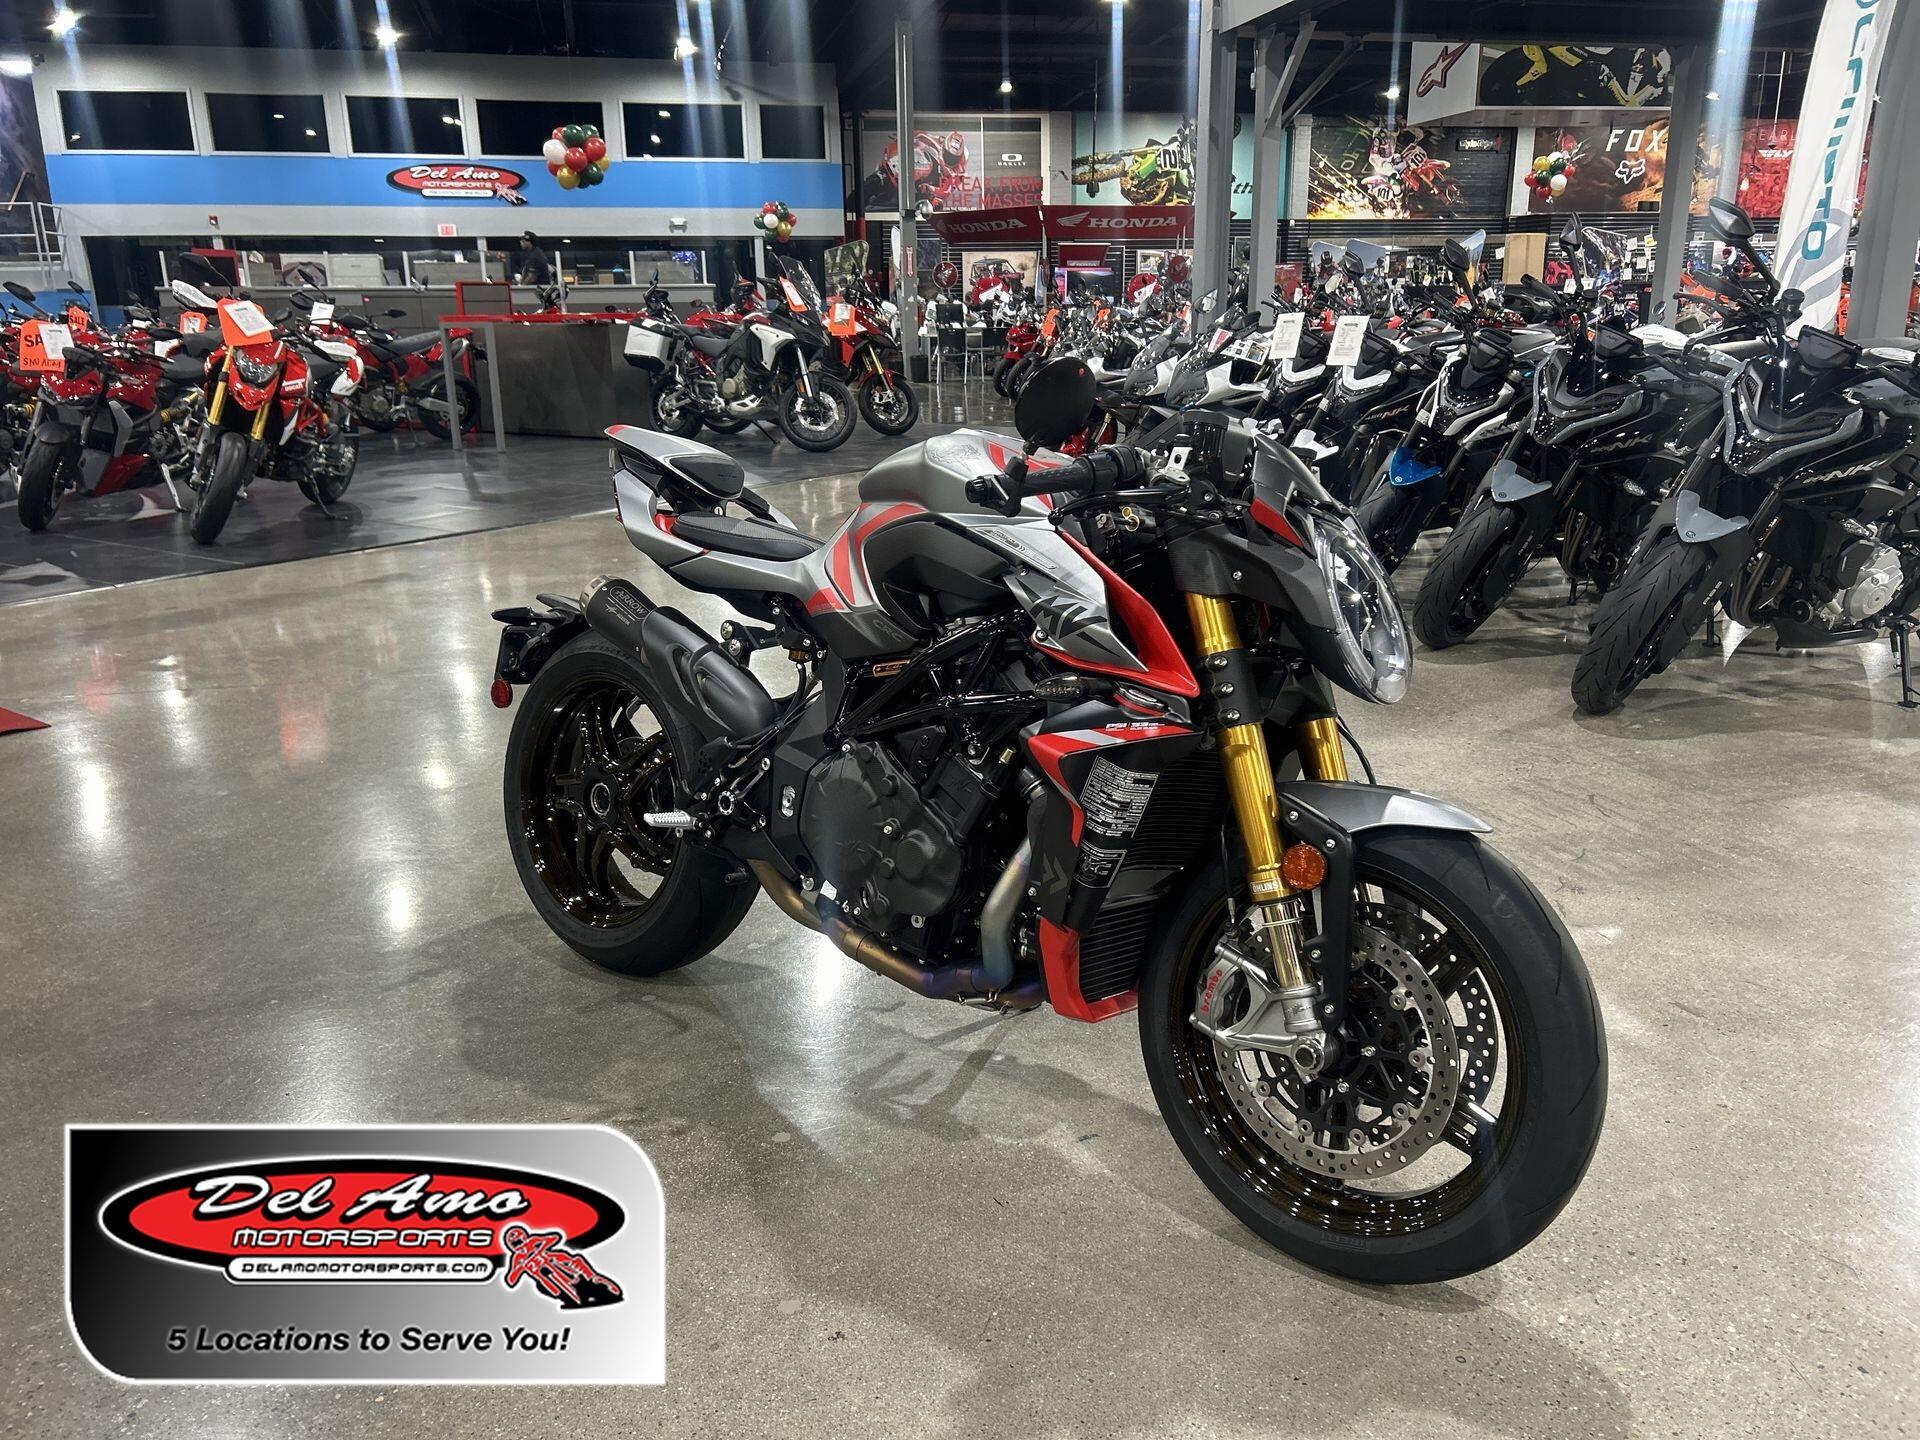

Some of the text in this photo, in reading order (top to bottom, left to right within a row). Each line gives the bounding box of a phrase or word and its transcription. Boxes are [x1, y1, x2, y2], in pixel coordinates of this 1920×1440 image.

[1605, 129, 1668, 152] FOX
[1749, 129, 1797, 141] FEARL
[410, 165, 500, 180] Del Amo
[422, 180, 492, 188] MOTORSPORTS
[977, 192, 1042, 208] MASSES
[949, 218, 1028, 234] HONDA
[1087, 216, 1177, 229] HONDA
[69, 315, 85, 326] SALE
[24, 334, 45, 348] SA
[614, 589, 648, 615] ARROW
[1200, 968, 1223, 1014] brembo
